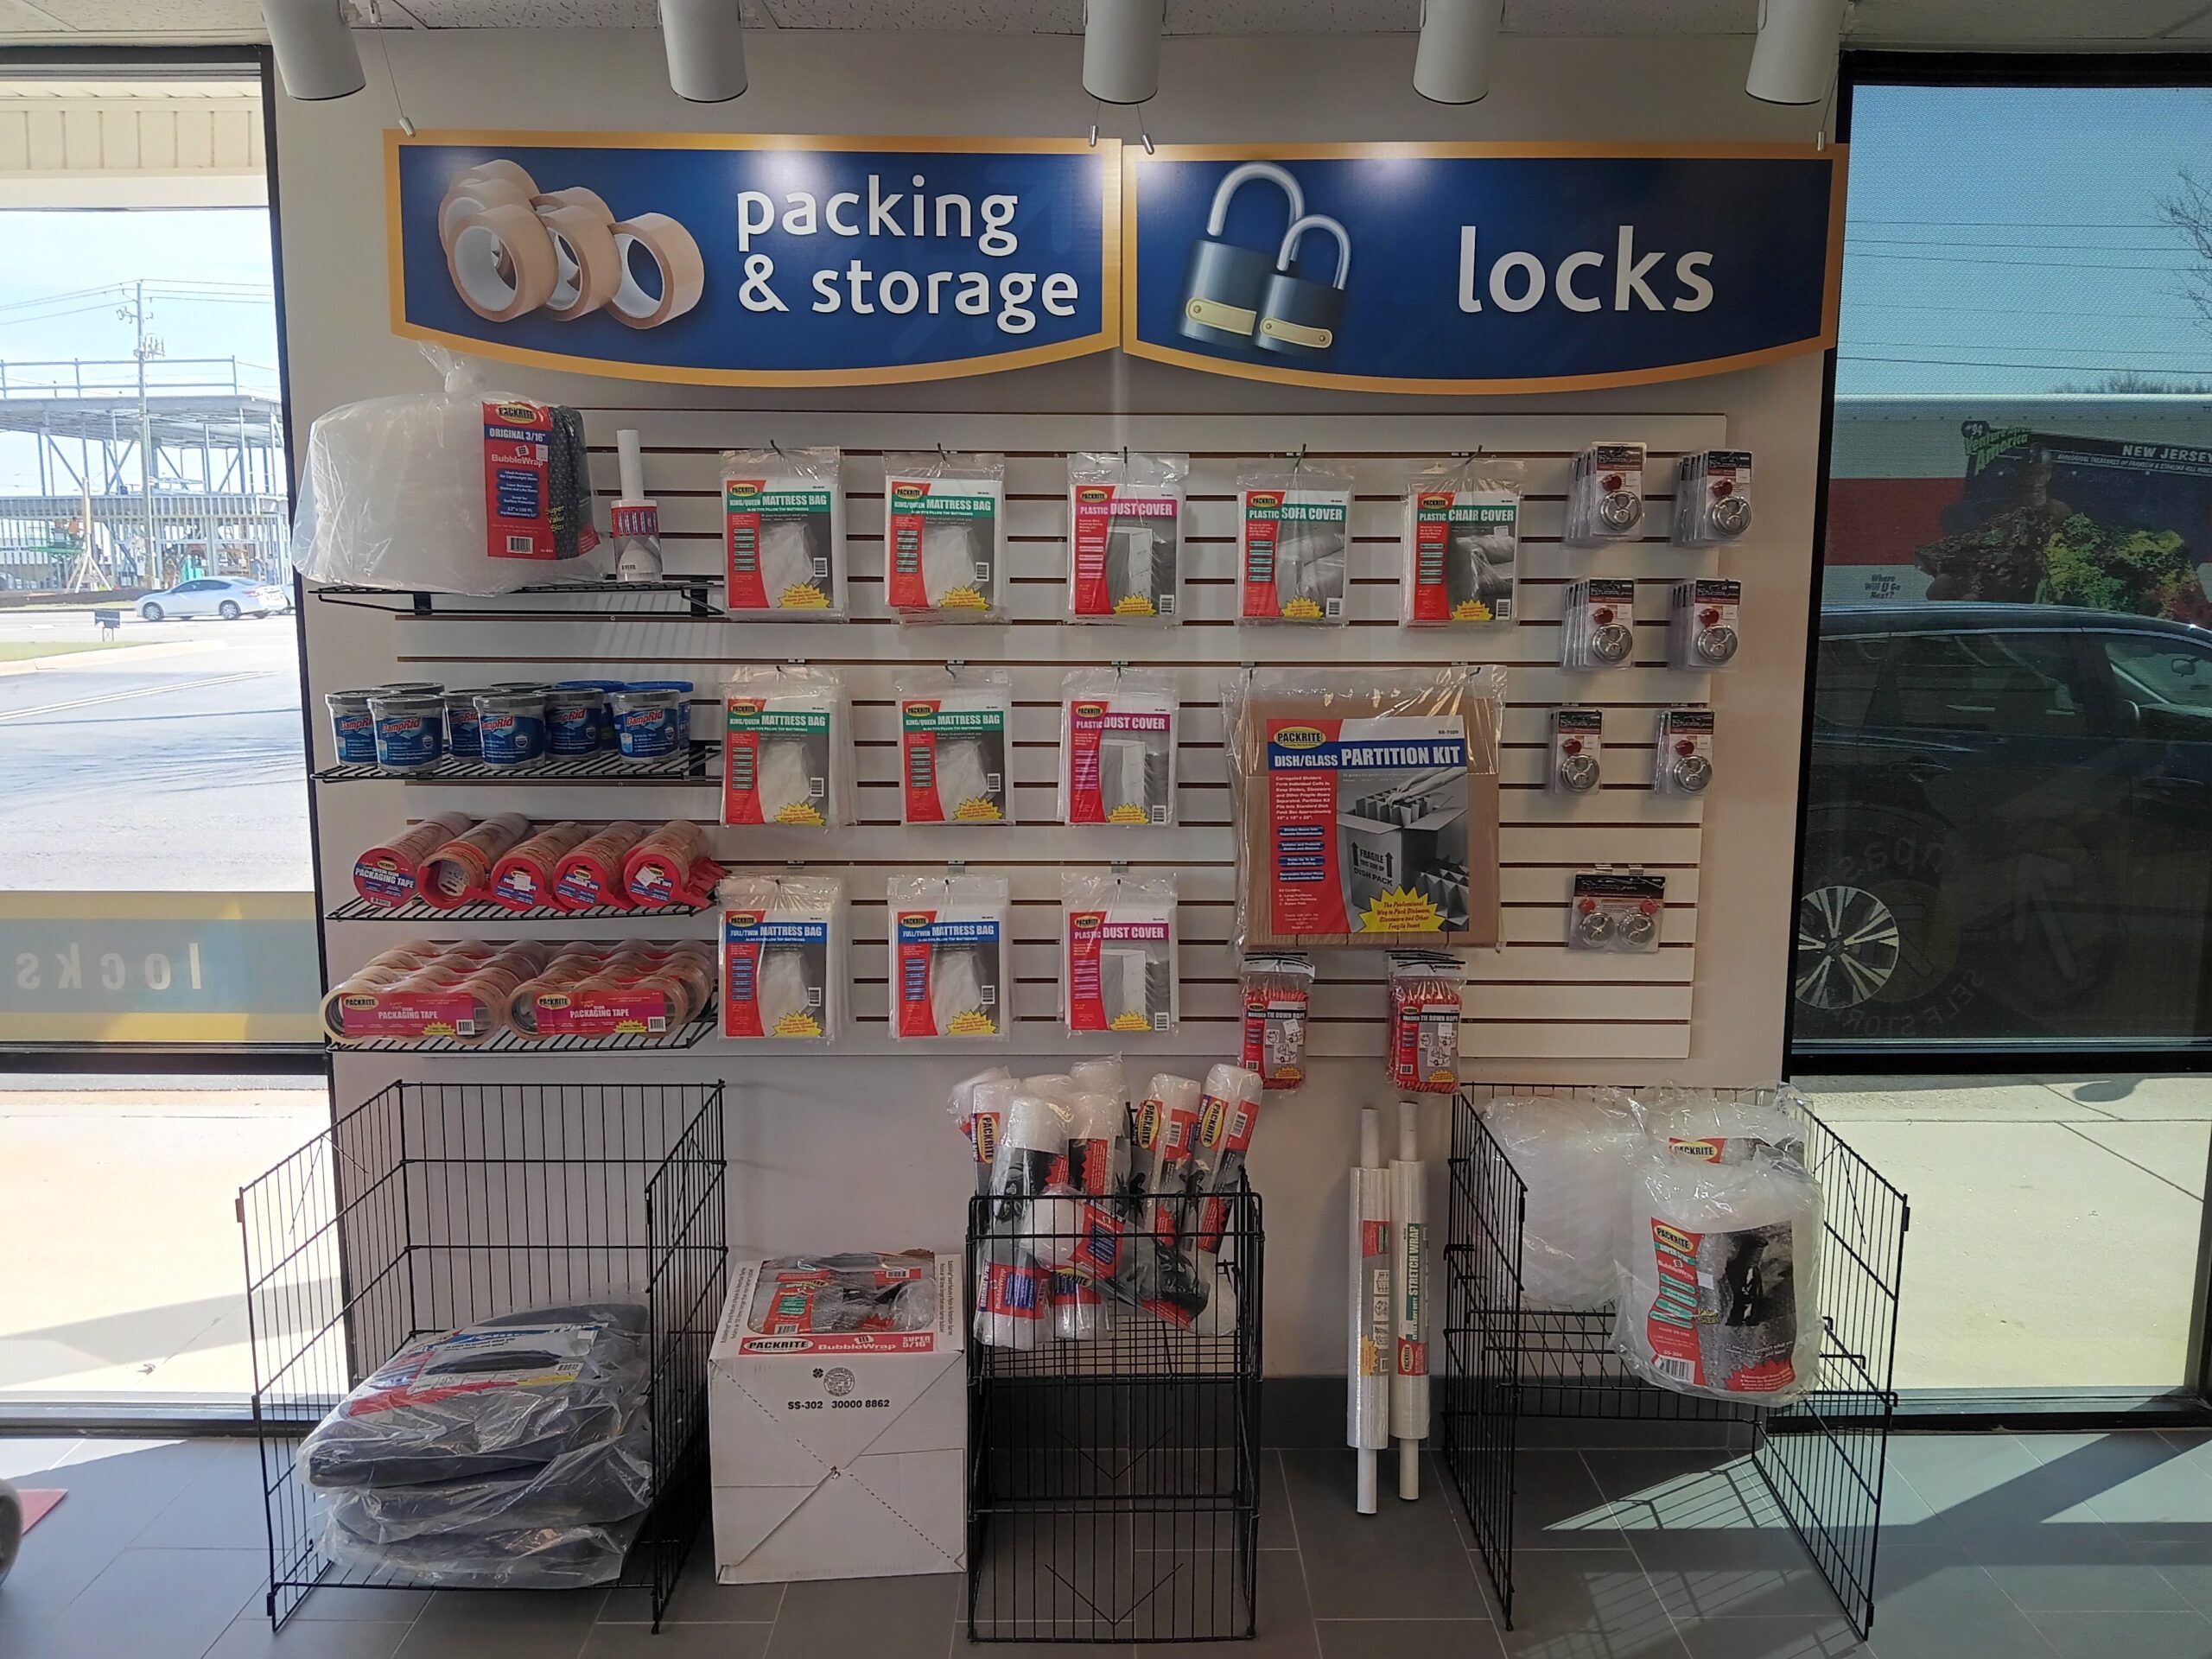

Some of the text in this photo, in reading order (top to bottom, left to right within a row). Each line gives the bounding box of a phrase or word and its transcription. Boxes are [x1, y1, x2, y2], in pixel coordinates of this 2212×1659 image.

[735, 174, 1020, 257] packing
[1459, 225, 1716, 314] locks
[738, 254, 1081, 335] & storage
[489, 428, 546, 442] ORIGINAL 3/16"
[2122, 445, 2157, 457] NEW
[492, 454, 543, 467] BubbleWrap
[762, 496, 808, 505] MATTRESS
[809, 495, 826, 505] BAG
[926, 499, 971, 510] MATTRESS
[973, 501, 991, 511] BAG
[1110, 503, 1137, 515] DUST
[1139, 504, 1173, 516] COVER
[1249, 507, 1342, 520] PLASTIC SOFA COVER
[1448, 510, 1478, 521] CHAIR
[1481, 510, 1514, 521] COVER
[626, 710, 664, 726] DampRid
[761, 715, 806, 726] MATTRESS
[808, 716, 825, 726] BAG
[938, 715, 982, 725] MATTRESS
[982, 715, 1000, 724] BAG
[1103, 717, 1130, 728] DUST
[1132, 717, 1165, 729] COVER
[382, 717, 421, 733] DampRid
[1277, 733, 1322, 743] PACKRITE
[1274, 747, 1460, 767] DISH/GLASS PARTITION KIT
[1360, 848, 1384, 863] FRAGILE
[355, 867, 415, 887] PACKAGING TAPE
[1354, 867, 1393, 887] DISH PACK
[760, 926, 803, 936] MATTRESS
[804, 926, 822, 937] BAG
[932, 925, 975, 936] MATTRESS
[976, 925, 994, 935] BAG
[1103, 927, 1129, 938] DUST
[1131, 927, 1164, 938] COVER
[378, 1011, 419, 1020] PACKAGING
[569, 1008, 630, 1018] PACKAGING TAPE
[1141, 1104, 1154, 1145] PACKRITE
[1203, 1103, 1221, 1144] PACKRITE
[982, 1117, 994, 1160] PACKRITE
[1409, 1226, 1420, 1255] WRAP
[1656, 1227, 1690, 1249] PACKRITE
[1408, 1256, 1420, 1296] STRETCH
[995, 1268, 1007, 1309] BubbleWrap
[748, 1340, 809, 1350] PACKRITE
[818, 1342, 896, 1351] BubbleWrap
[831, 1400, 862, 1408] 30000
